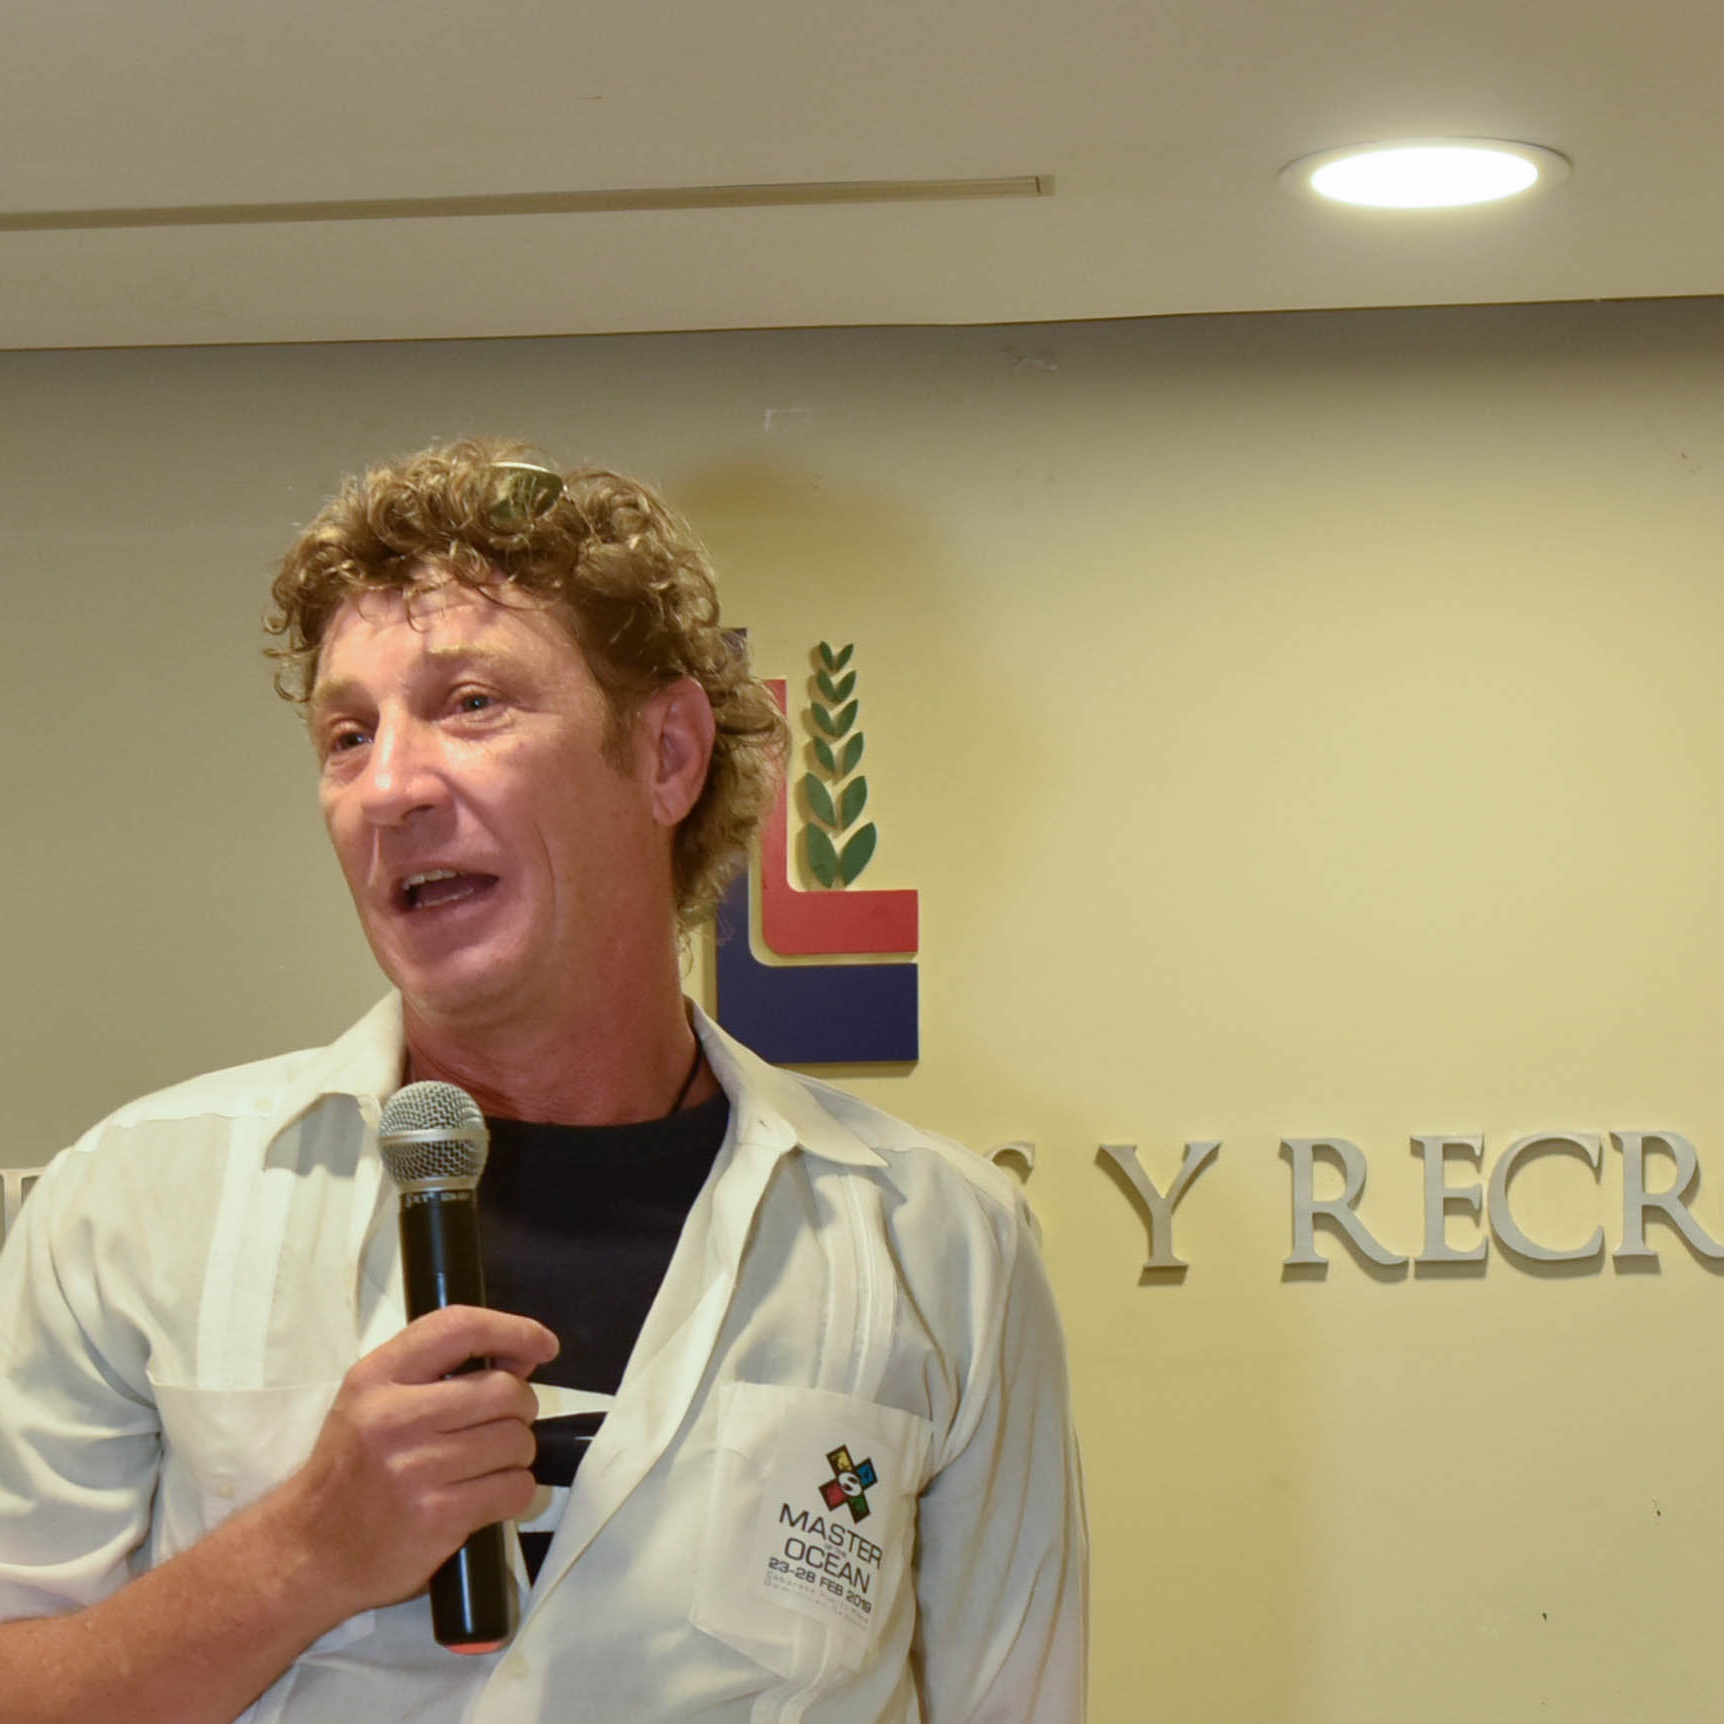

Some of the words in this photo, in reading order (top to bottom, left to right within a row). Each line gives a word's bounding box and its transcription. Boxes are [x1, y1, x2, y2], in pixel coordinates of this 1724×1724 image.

[1095, 1140, 1221, 1268] Y
[779, 1503, 883, 1569] MASTER
[784, 1537, 870, 1594] OCEAN
[768, 1557, 816, 1583] 23-28
[820, 1576, 844, 1597] FEB
